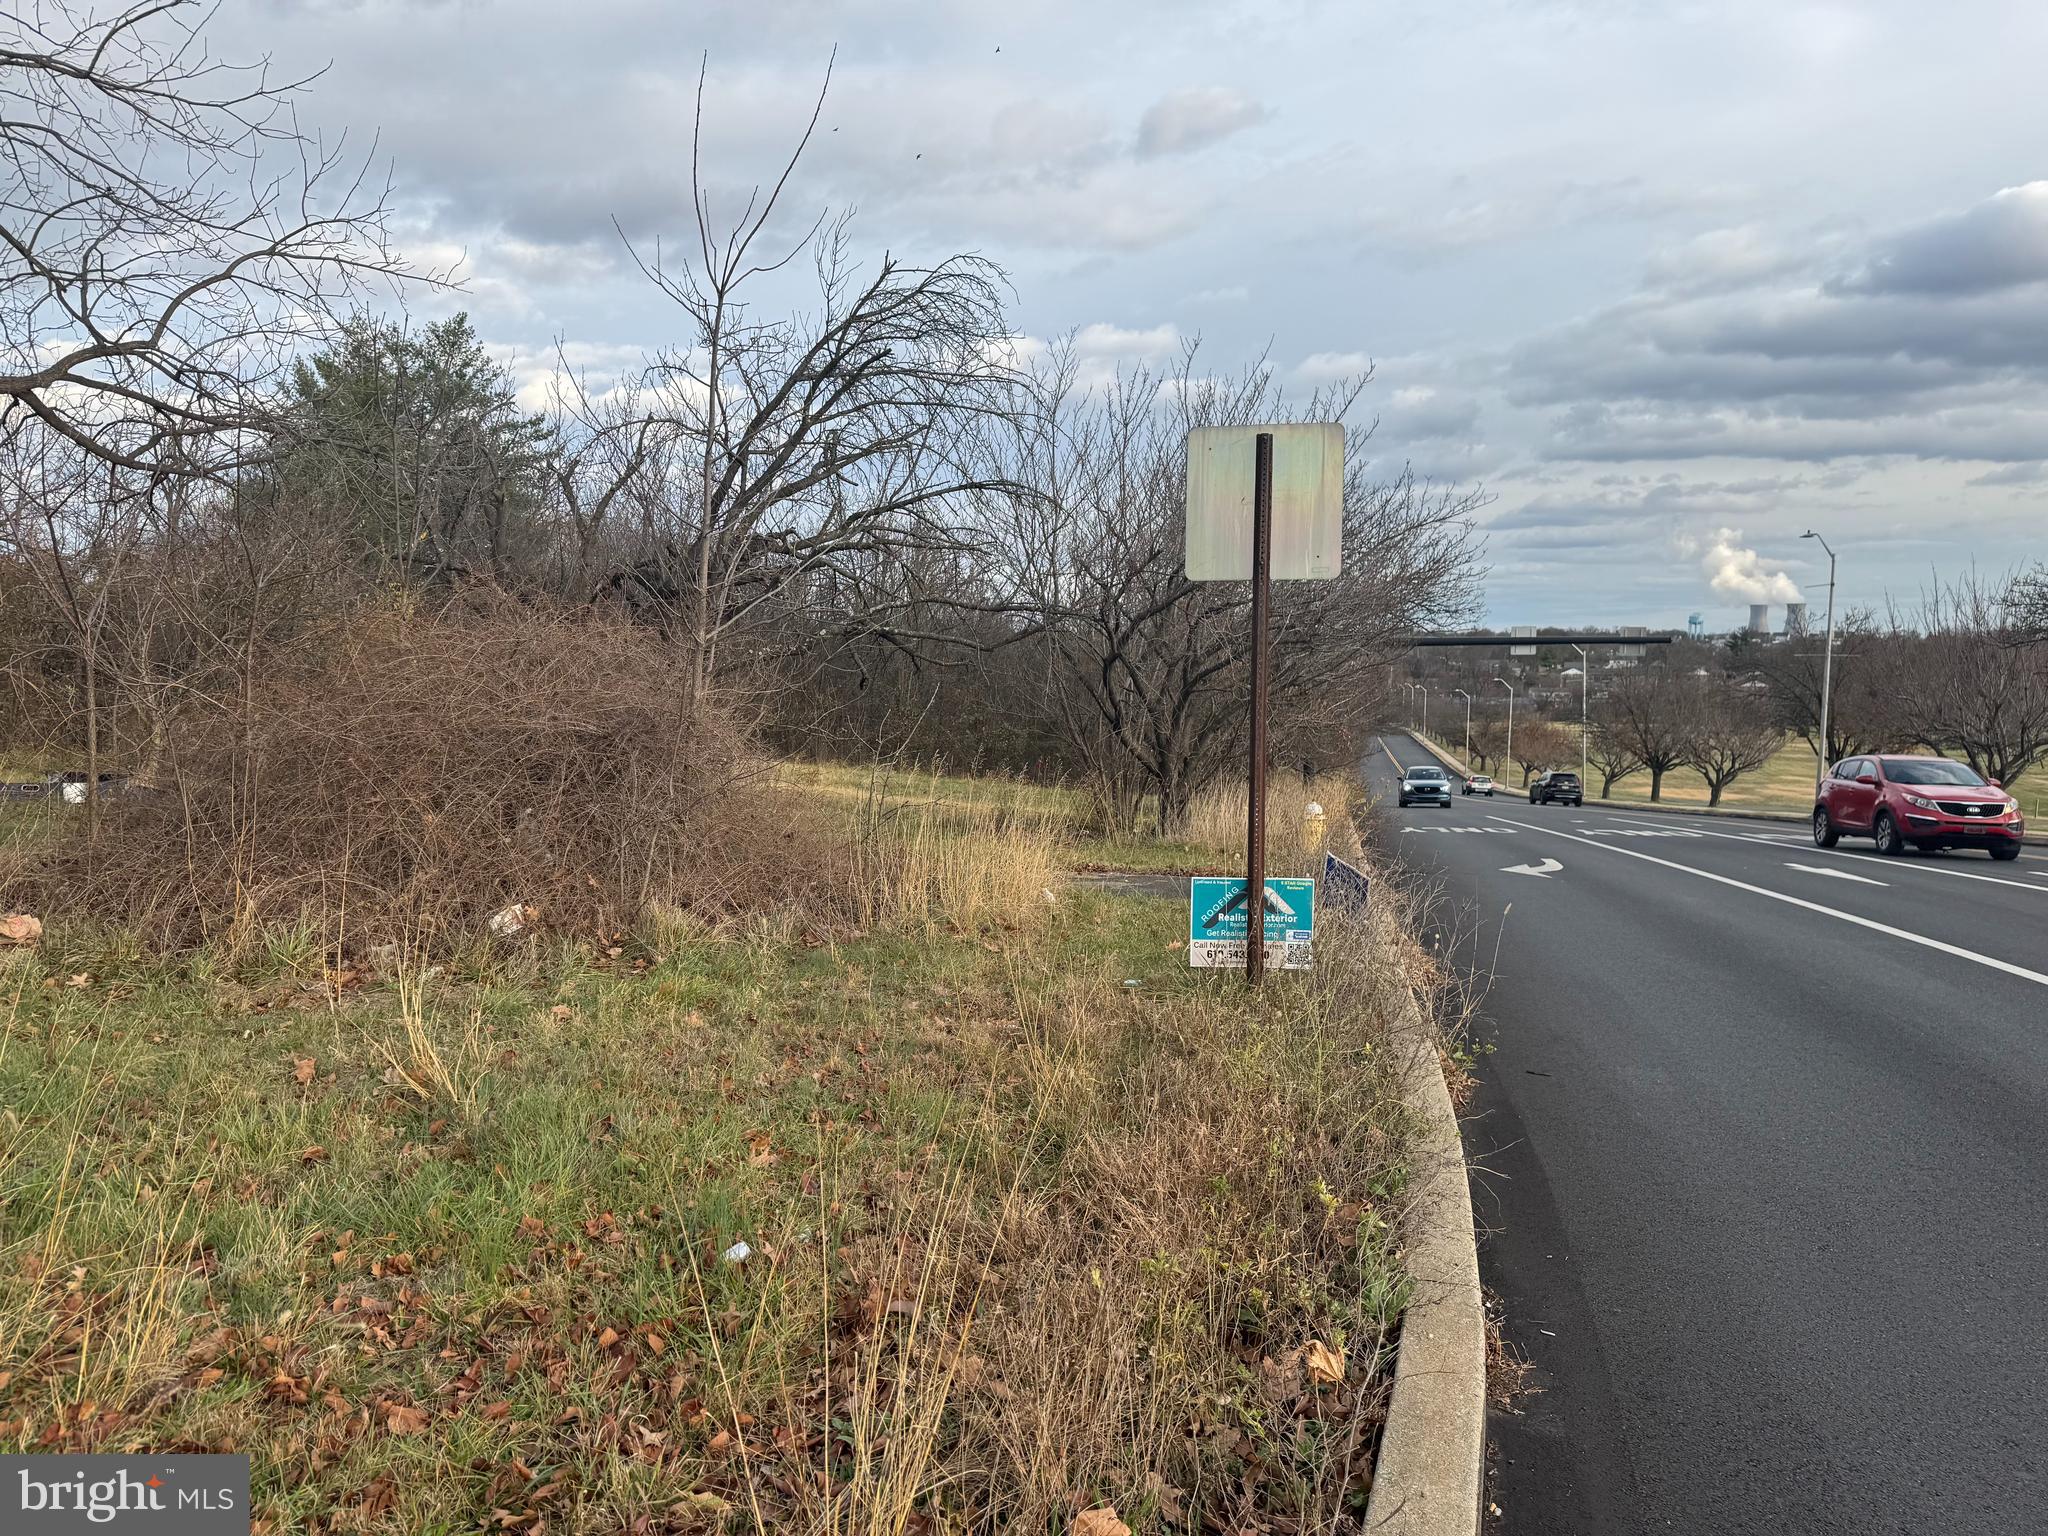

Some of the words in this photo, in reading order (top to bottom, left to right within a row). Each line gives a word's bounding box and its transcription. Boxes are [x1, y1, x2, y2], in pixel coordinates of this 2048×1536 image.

[1201, 886, 1239, 923] ROOFING
[1218, 913, 1248, 922] Realist
[1206, 929, 1220, 937] Get
[1221, 929, 1248, 937] Realisti
[1193, 941, 1208, 949] Call
